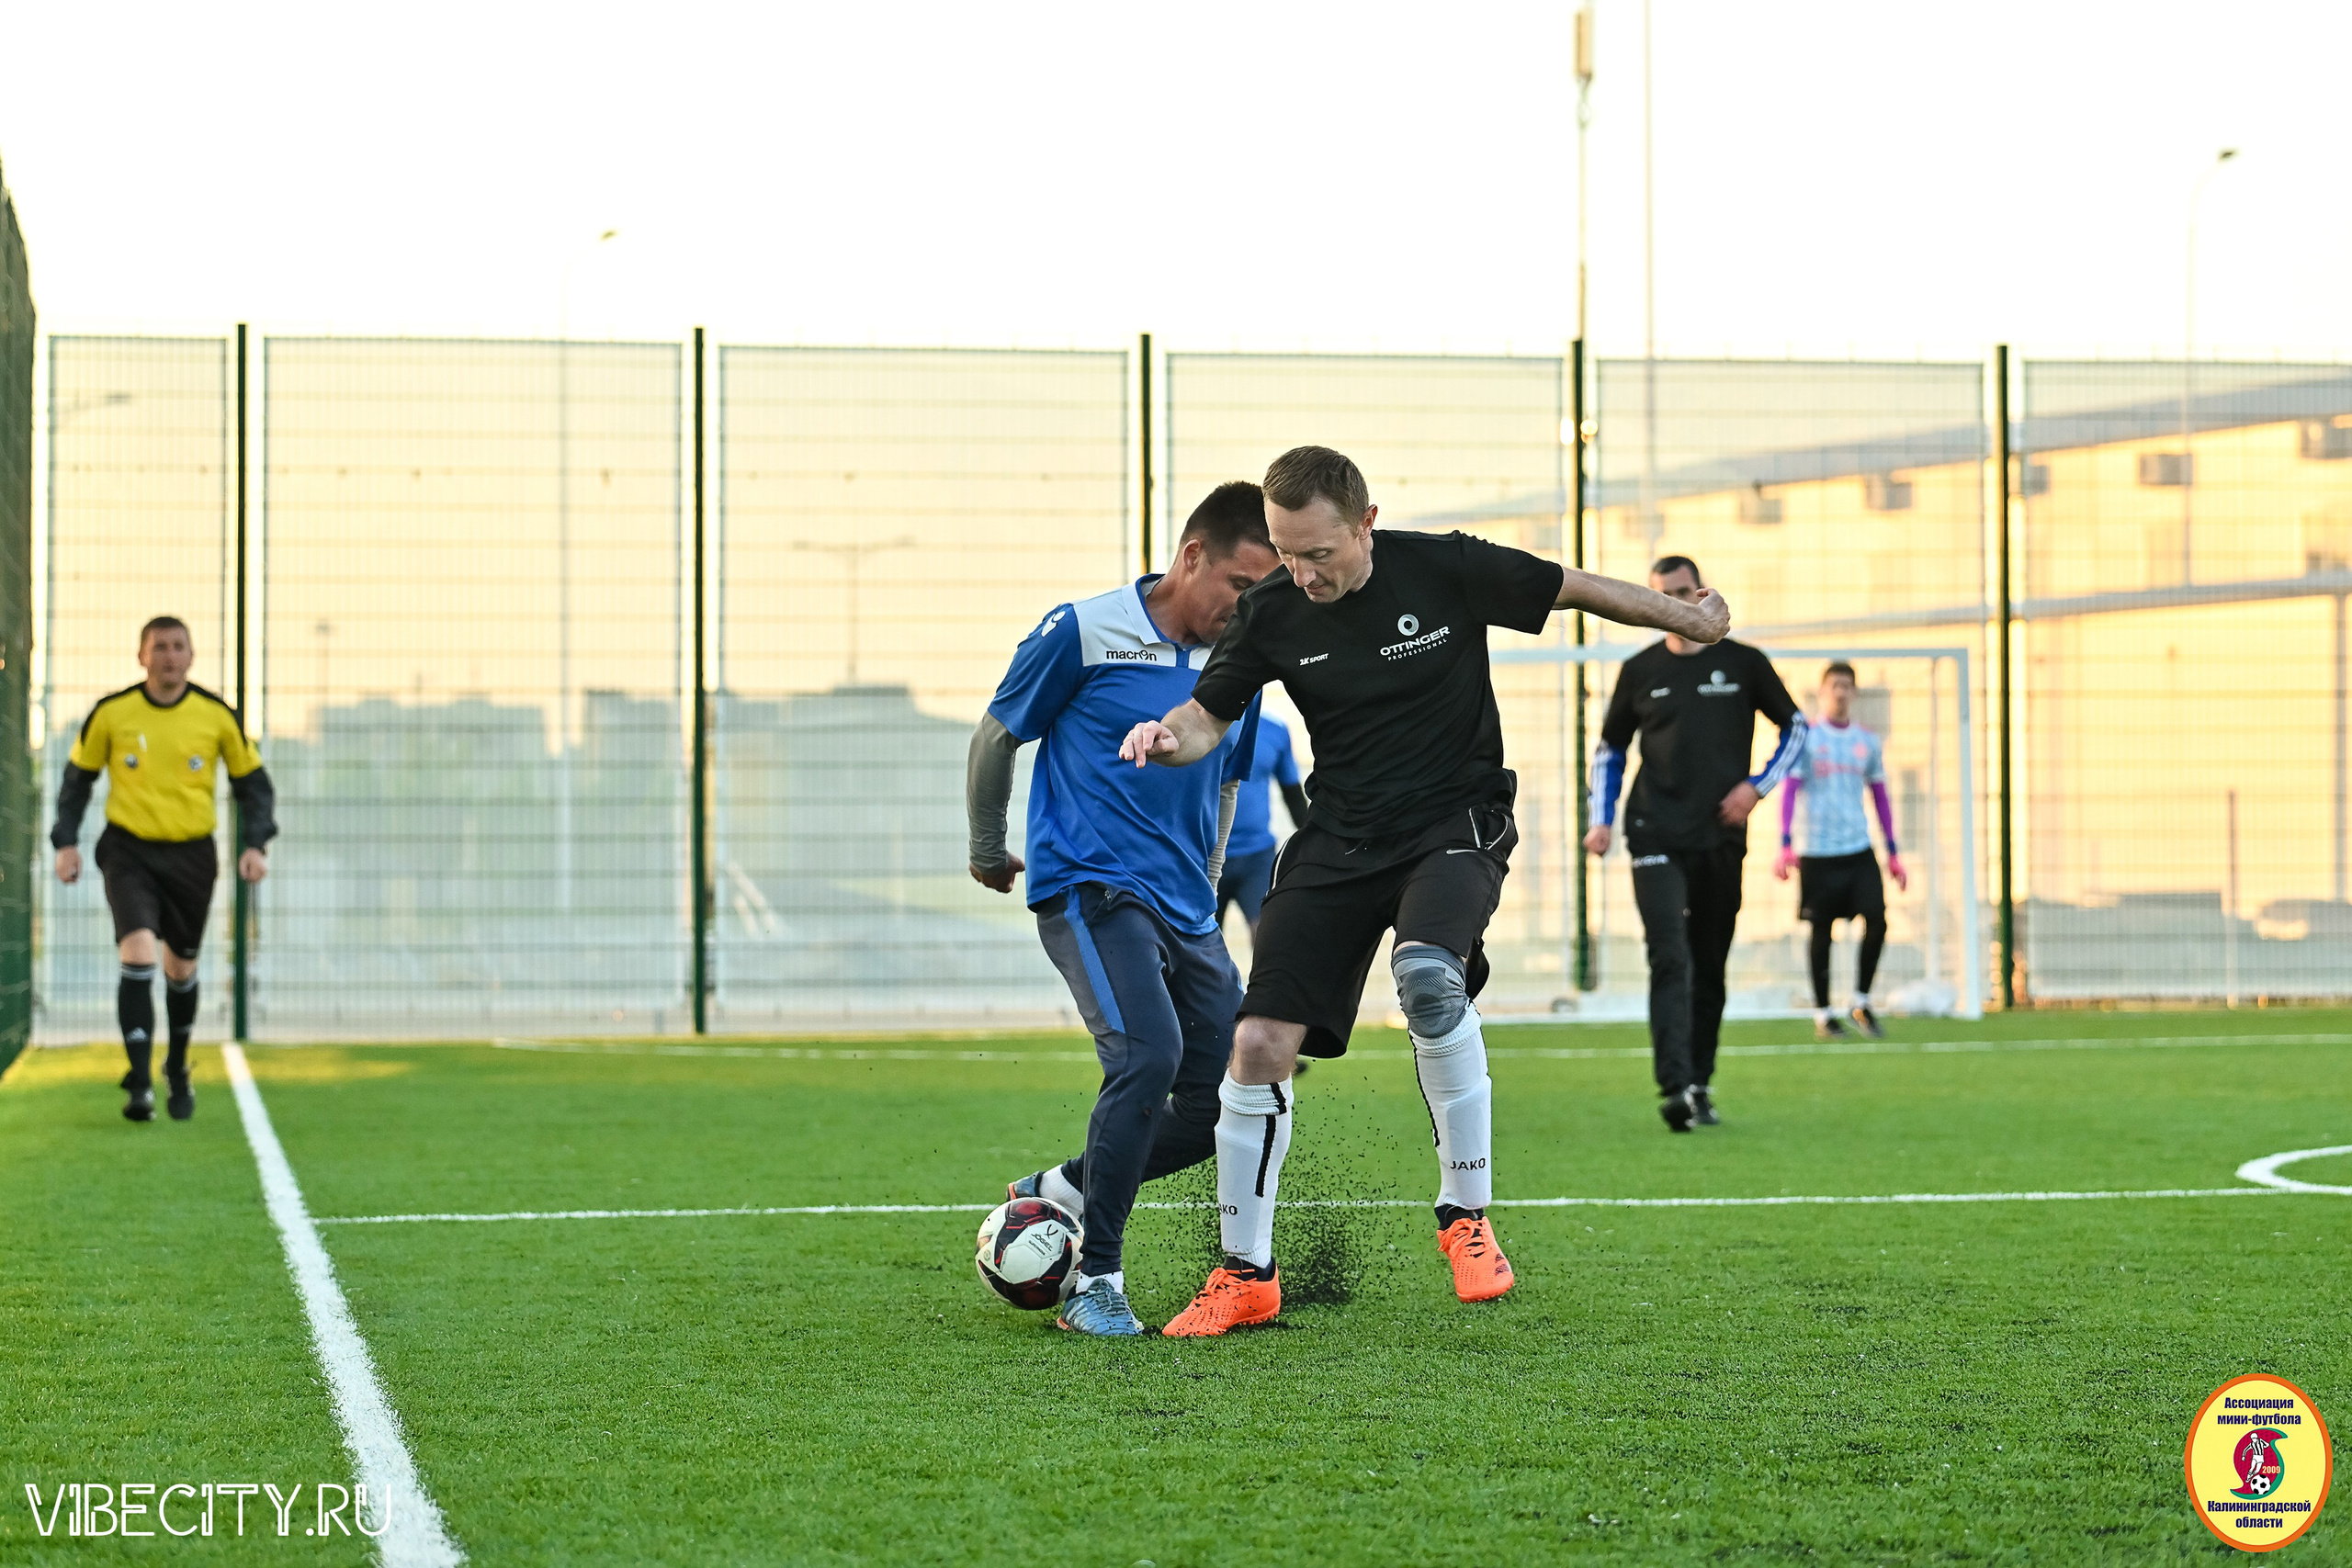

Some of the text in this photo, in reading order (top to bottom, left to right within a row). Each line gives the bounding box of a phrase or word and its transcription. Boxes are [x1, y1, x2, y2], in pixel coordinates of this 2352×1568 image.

[1380, 626, 1451, 656] OTTINGER
[1106, 649, 1157, 661] macron
[1387, 638, 1447, 660] PROFESSIONAL
[1309, 653, 1329, 663] SPORT
[1450, 1157, 1486, 1171] JAKO
